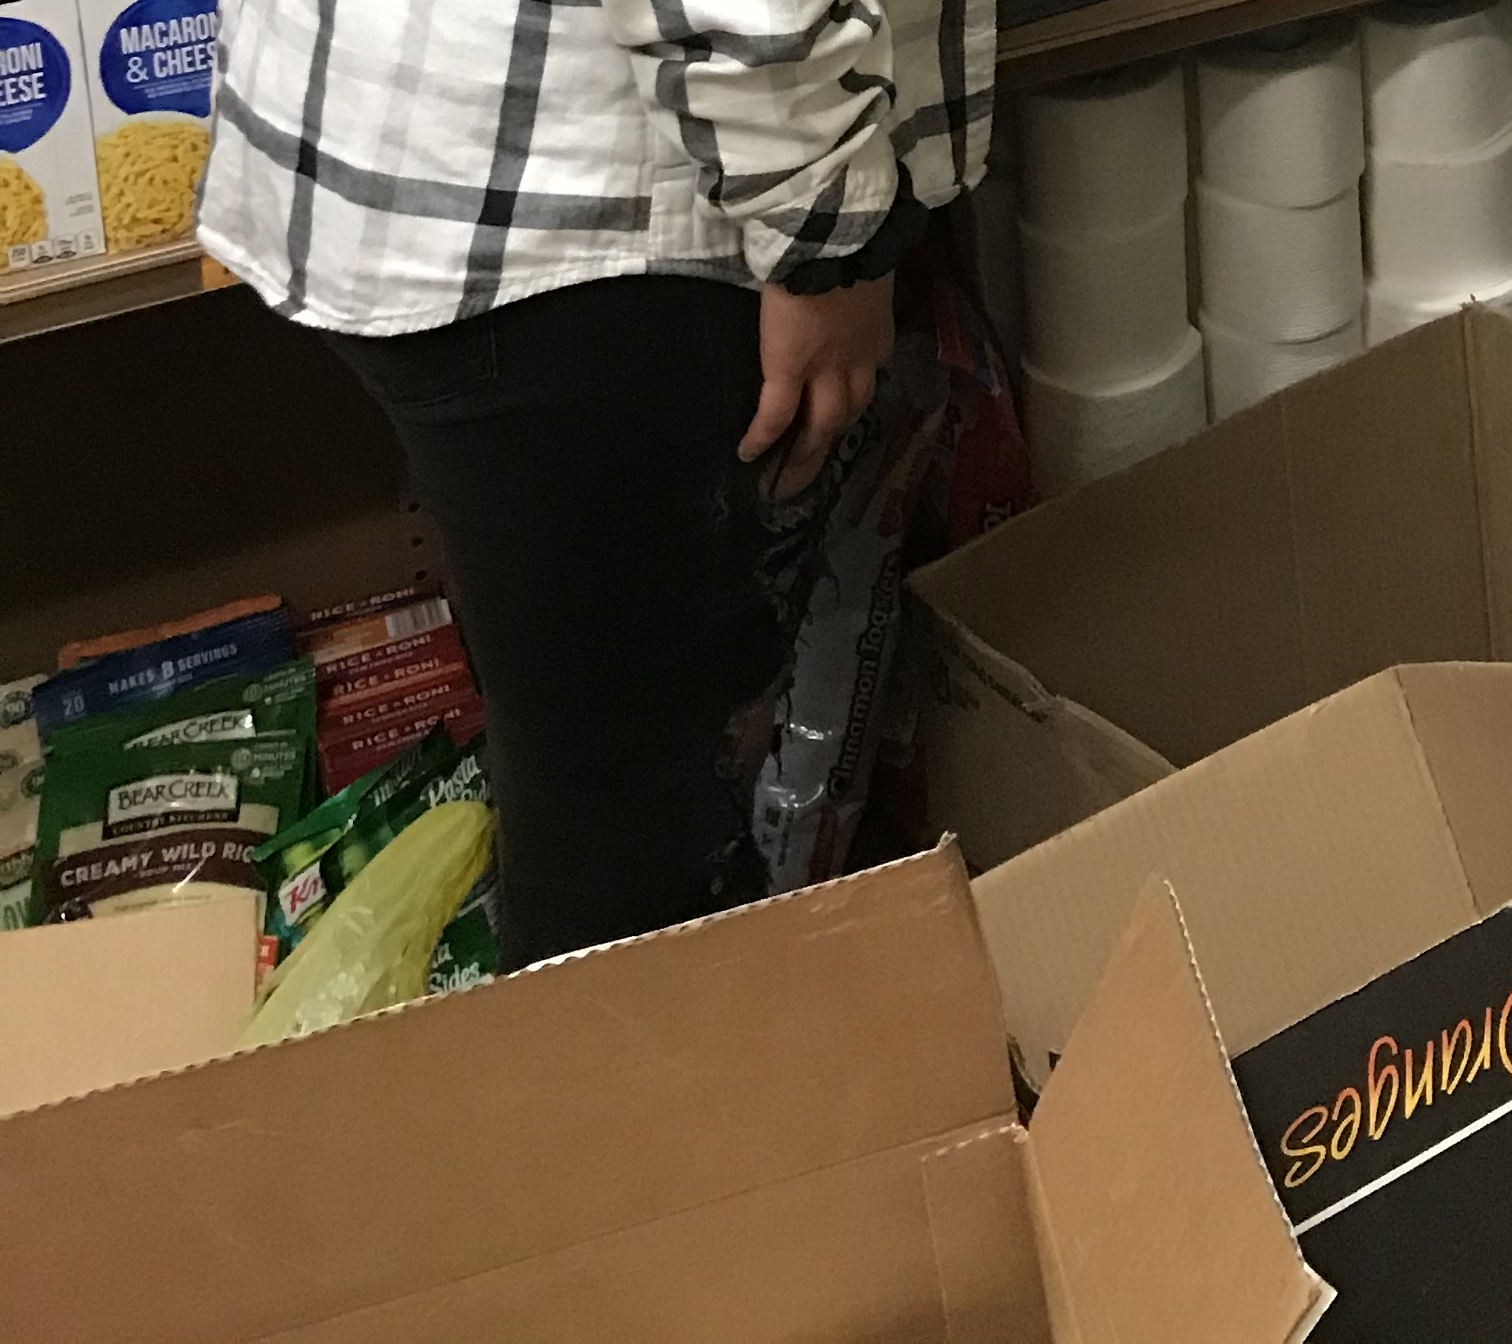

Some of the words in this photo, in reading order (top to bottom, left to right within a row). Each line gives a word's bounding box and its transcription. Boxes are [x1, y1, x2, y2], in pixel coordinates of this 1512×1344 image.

[120, 11, 220, 55] MACARON
[126, 56, 150, 84] &
[153, 41, 218, 78] CHEES
[108, 668, 156, 695] MAKES
[160, 660, 176, 681] 8
[176, 641, 239, 672] SERVINGS
[117, 781, 168, 810] BEAR
[167, 776, 229, 799] CREEK
[419, 754, 483, 810] Pasta
[60, 850, 154, 889] CREAMY
[160, 839, 217, 863] WILD
[222, 840, 257, 863] RIC
[427, 964, 482, 996] Sides
